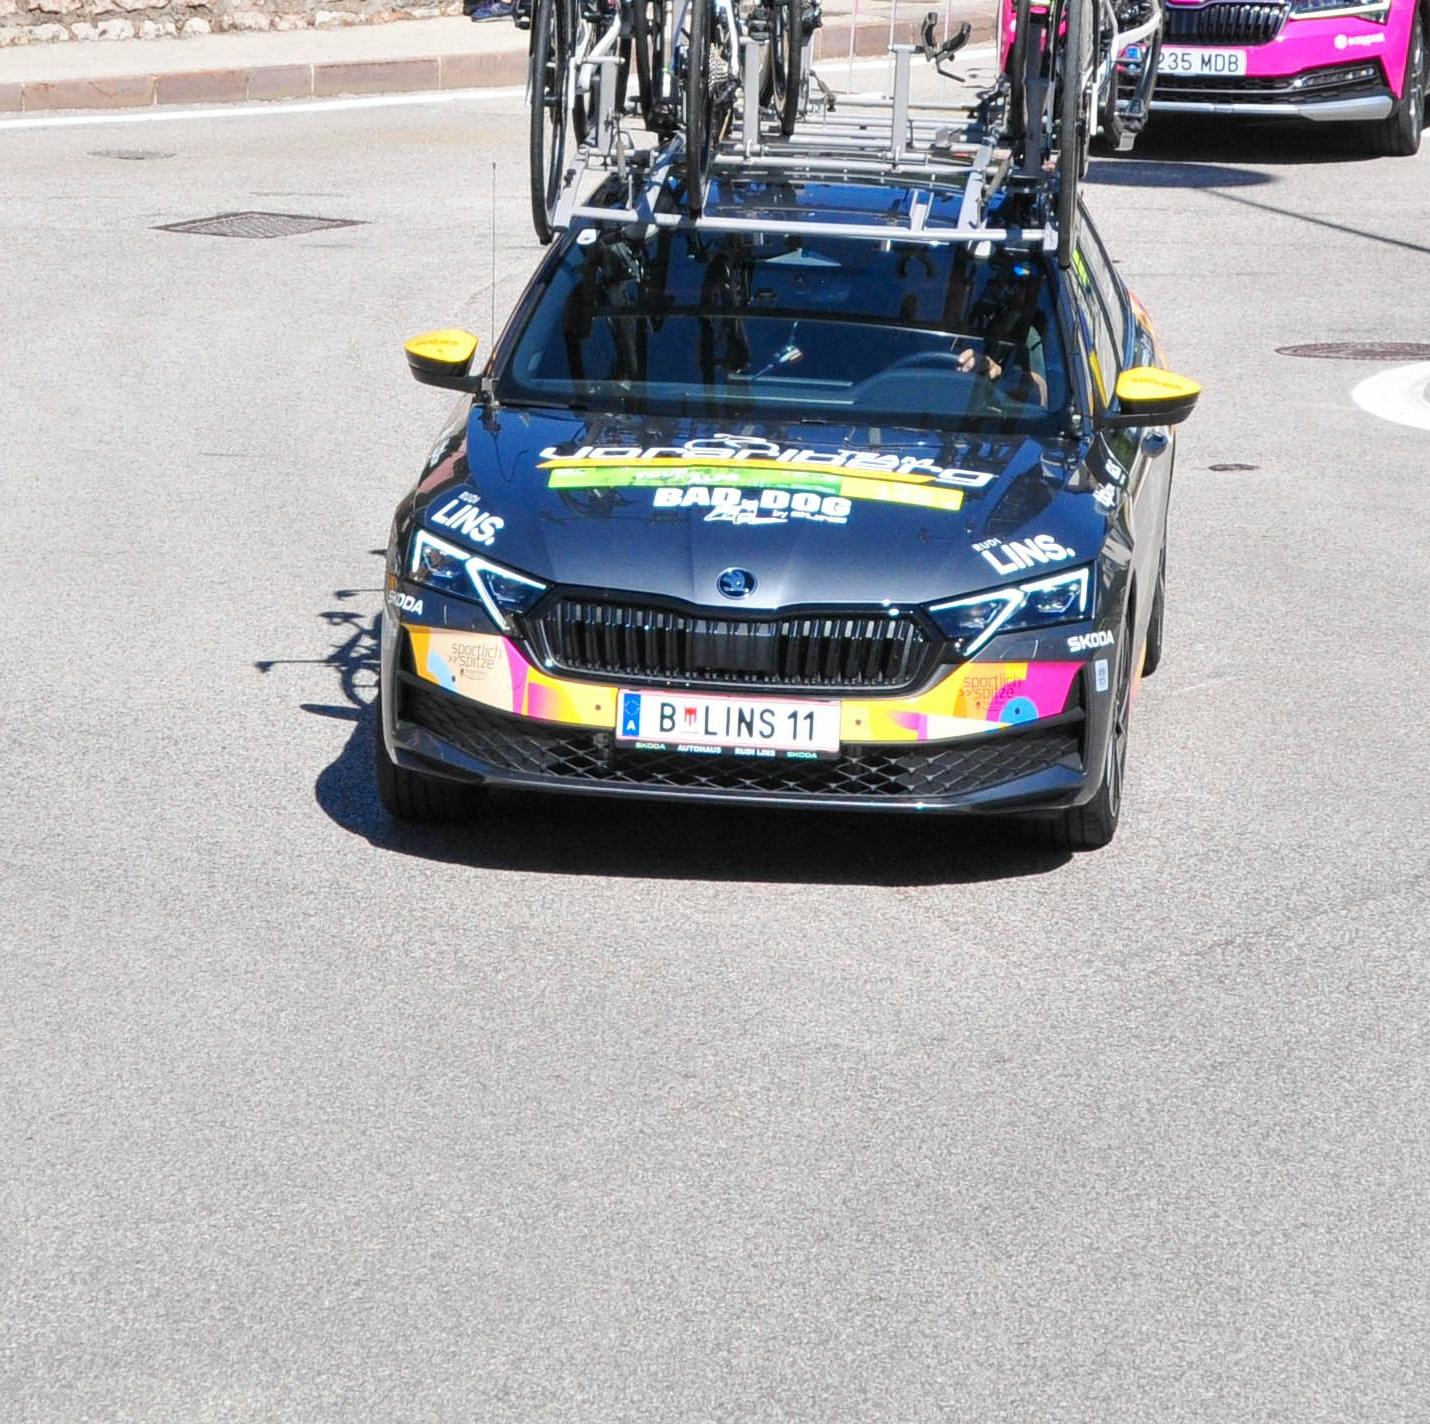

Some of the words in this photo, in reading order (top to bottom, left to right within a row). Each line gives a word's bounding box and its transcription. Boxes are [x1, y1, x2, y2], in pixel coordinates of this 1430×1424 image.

[1156, 50, 1193, 72] 235
[1200, 51, 1240, 74] MDB
[652, 486, 742, 508] BAD
[760, 489, 852, 517] DOG
[972, 537, 1003, 553] RUDI
[451, 642, 502, 659] sportlich
[1067, 630, 1115, 654] SKODA
[962, 673, 1022, 692] sportlich
[626, 720, 636, 731] A
[659, 702, 677, 733] B
[704, 705, 776, 740] LINS
[787, 709, 815, 742] 11
[677, 744, 722, 755] AUTOHAUS
[734, 746, 755, 756] RUDI
